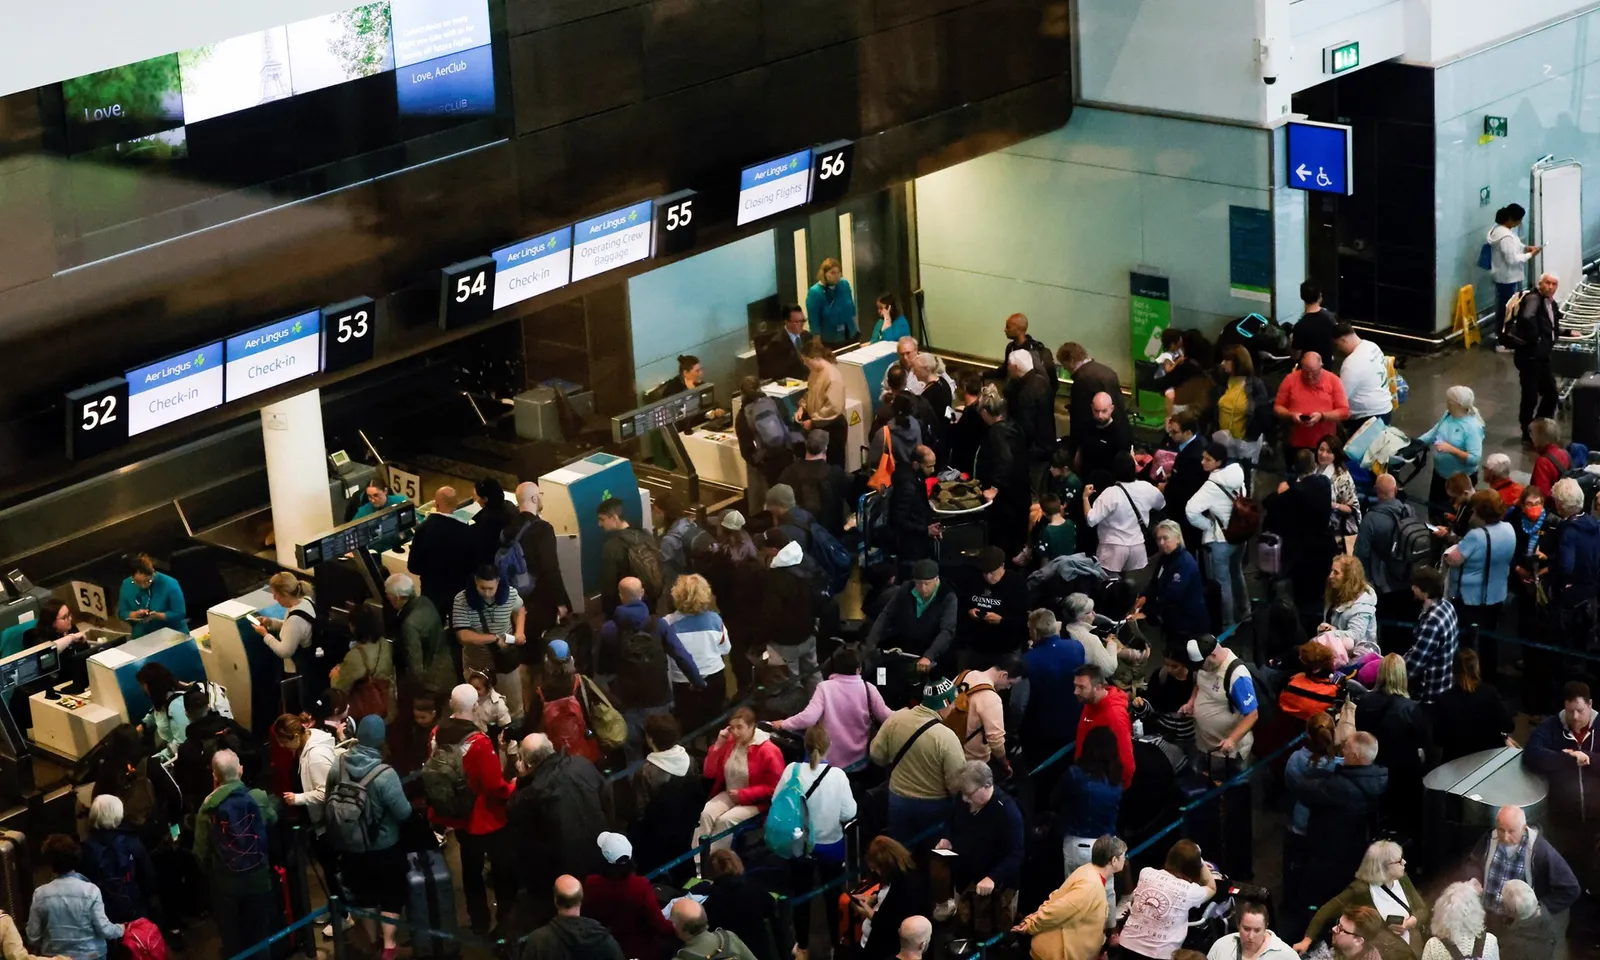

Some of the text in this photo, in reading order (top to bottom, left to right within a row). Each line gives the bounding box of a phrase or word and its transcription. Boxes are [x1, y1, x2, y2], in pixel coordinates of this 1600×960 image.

[411, 60, 467, 84] Love, AerClub
[754, 163, 788, 181] Aer Lingus
[819, 152, 845, 180] 56
[744, 183, 802, 210] Closing Flights
[589, 214, 626, 235] Aer Lingus
[666, 200, 693, 231] 55
[507, 242, 546, 262] Aer Lingus
[581, 231, 644, 259] Operating Crew
[594, 247, 629, 267] Baggage
[455, 270, 487, 303] 54
[508, 267, 550, 290] Check-in
[244, 327, 289, 350] Aer Lingus
[337, 310, 368, 343] 53
[145, 360, 191, 383] Aer Lingus
[248, 355, 296, 380] Check-in
[81, 395, 116, 430] 52
[148, 387, 199, 414] Check-in
[393, 474, 416, 499] 55
[80, 588, 103, 612] 53
[971, 594, 1002, 606] GUINNESS
